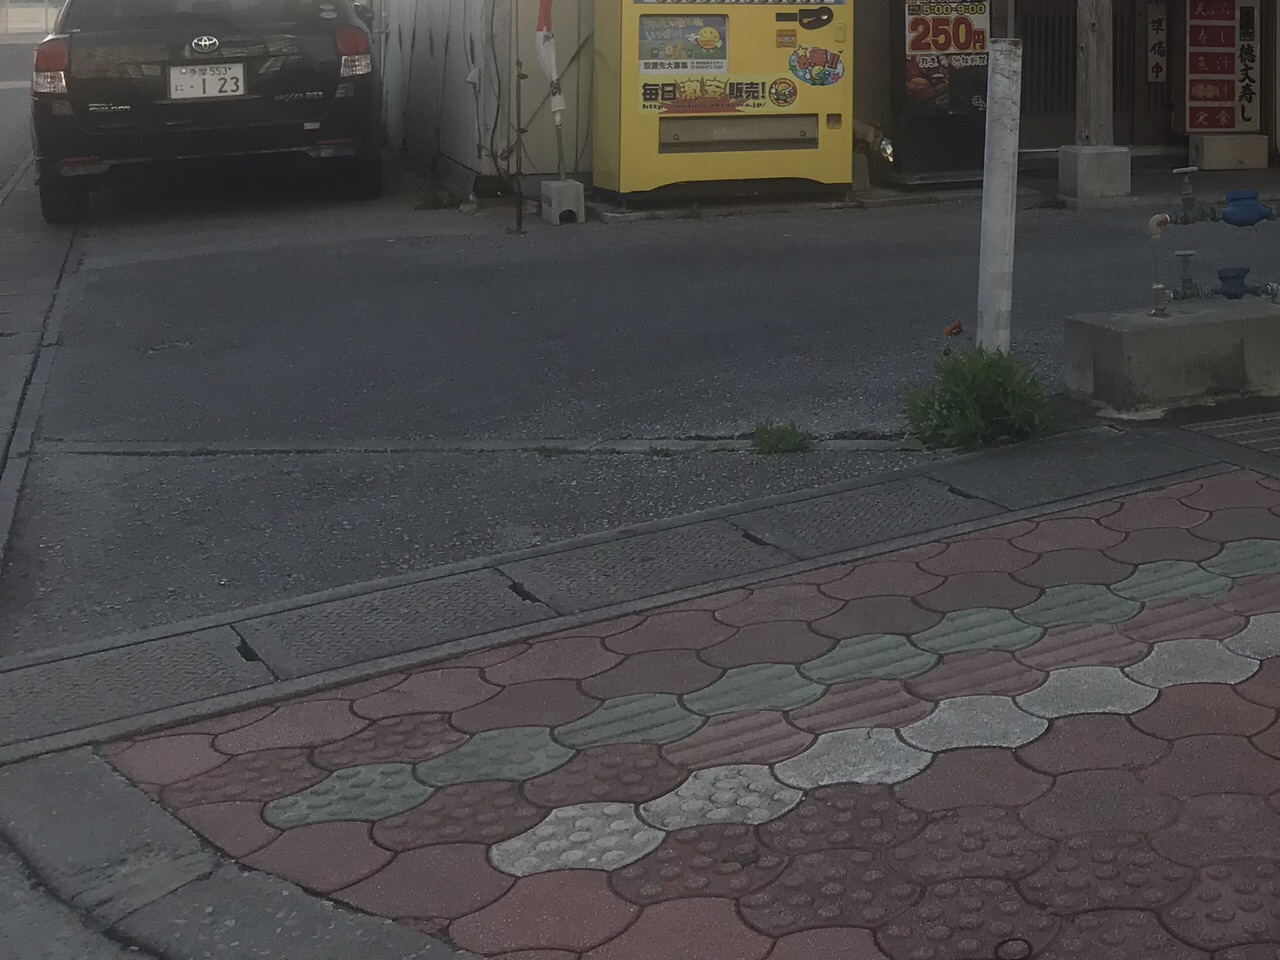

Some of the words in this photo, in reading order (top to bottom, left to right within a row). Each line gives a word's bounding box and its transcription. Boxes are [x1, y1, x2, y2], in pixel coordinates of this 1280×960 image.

[910, 16, 985, 51] 250円
[1238, 44, 1256, 122] 徳文寿し
